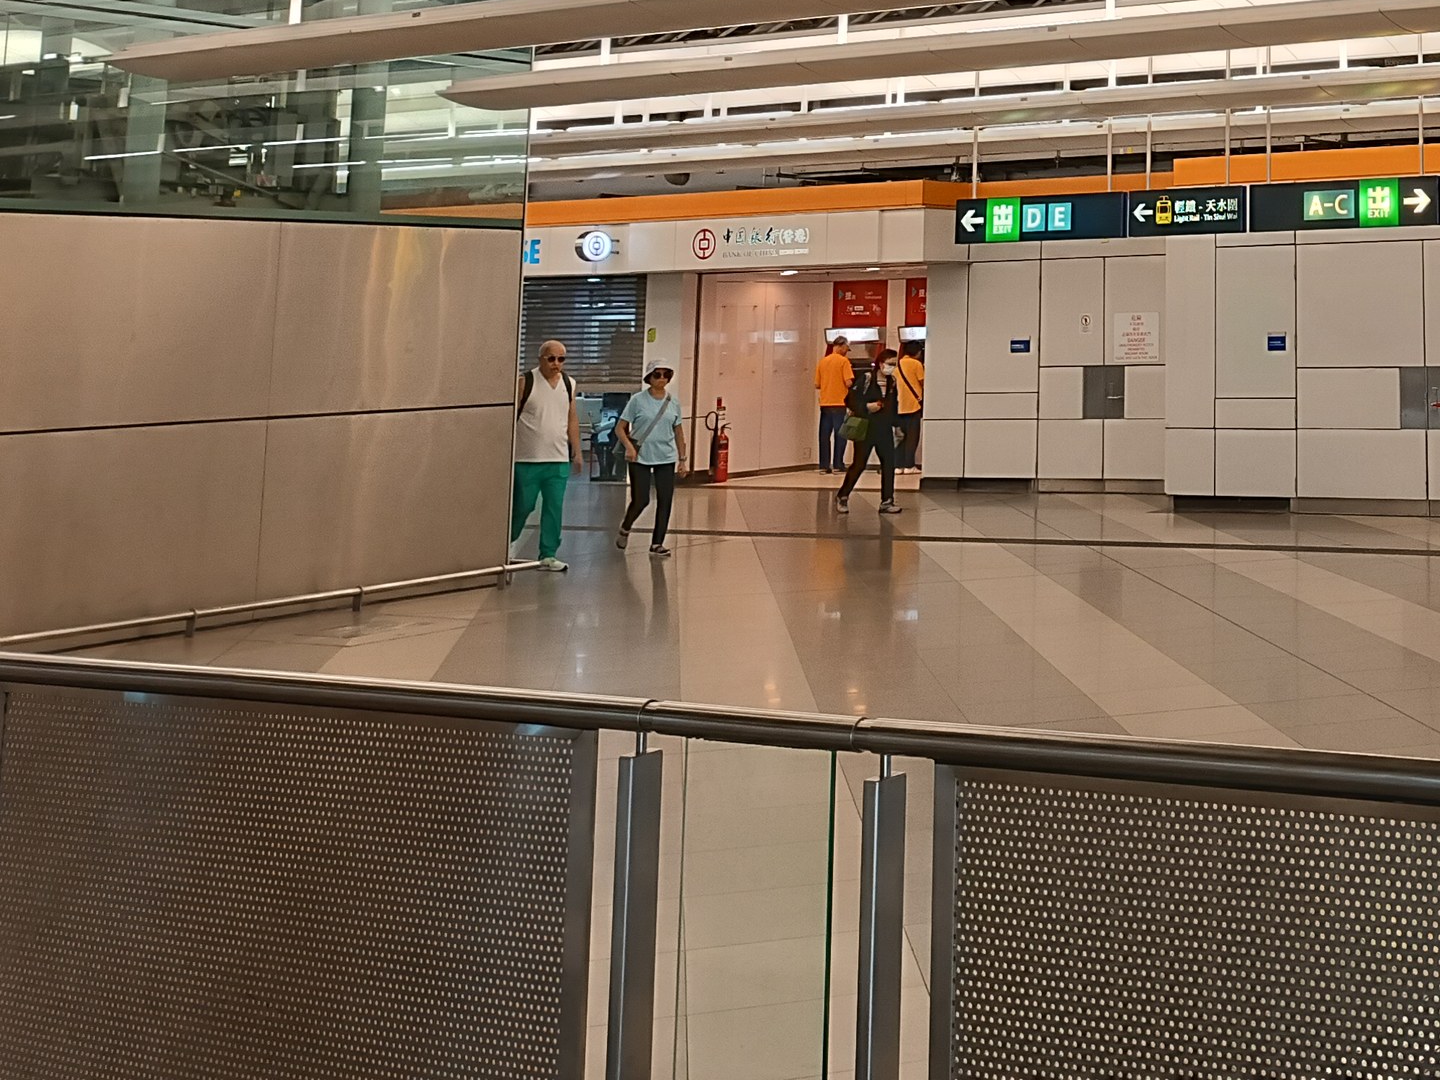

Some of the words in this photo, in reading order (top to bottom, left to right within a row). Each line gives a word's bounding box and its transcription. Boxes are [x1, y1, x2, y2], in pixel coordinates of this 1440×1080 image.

[1026, 207, 1042, 229] D
[1053, 206, 1066, 227] E
[1367, 209, 1390, 219] EXIT
[992, 224, 1013, 235] EXIT
